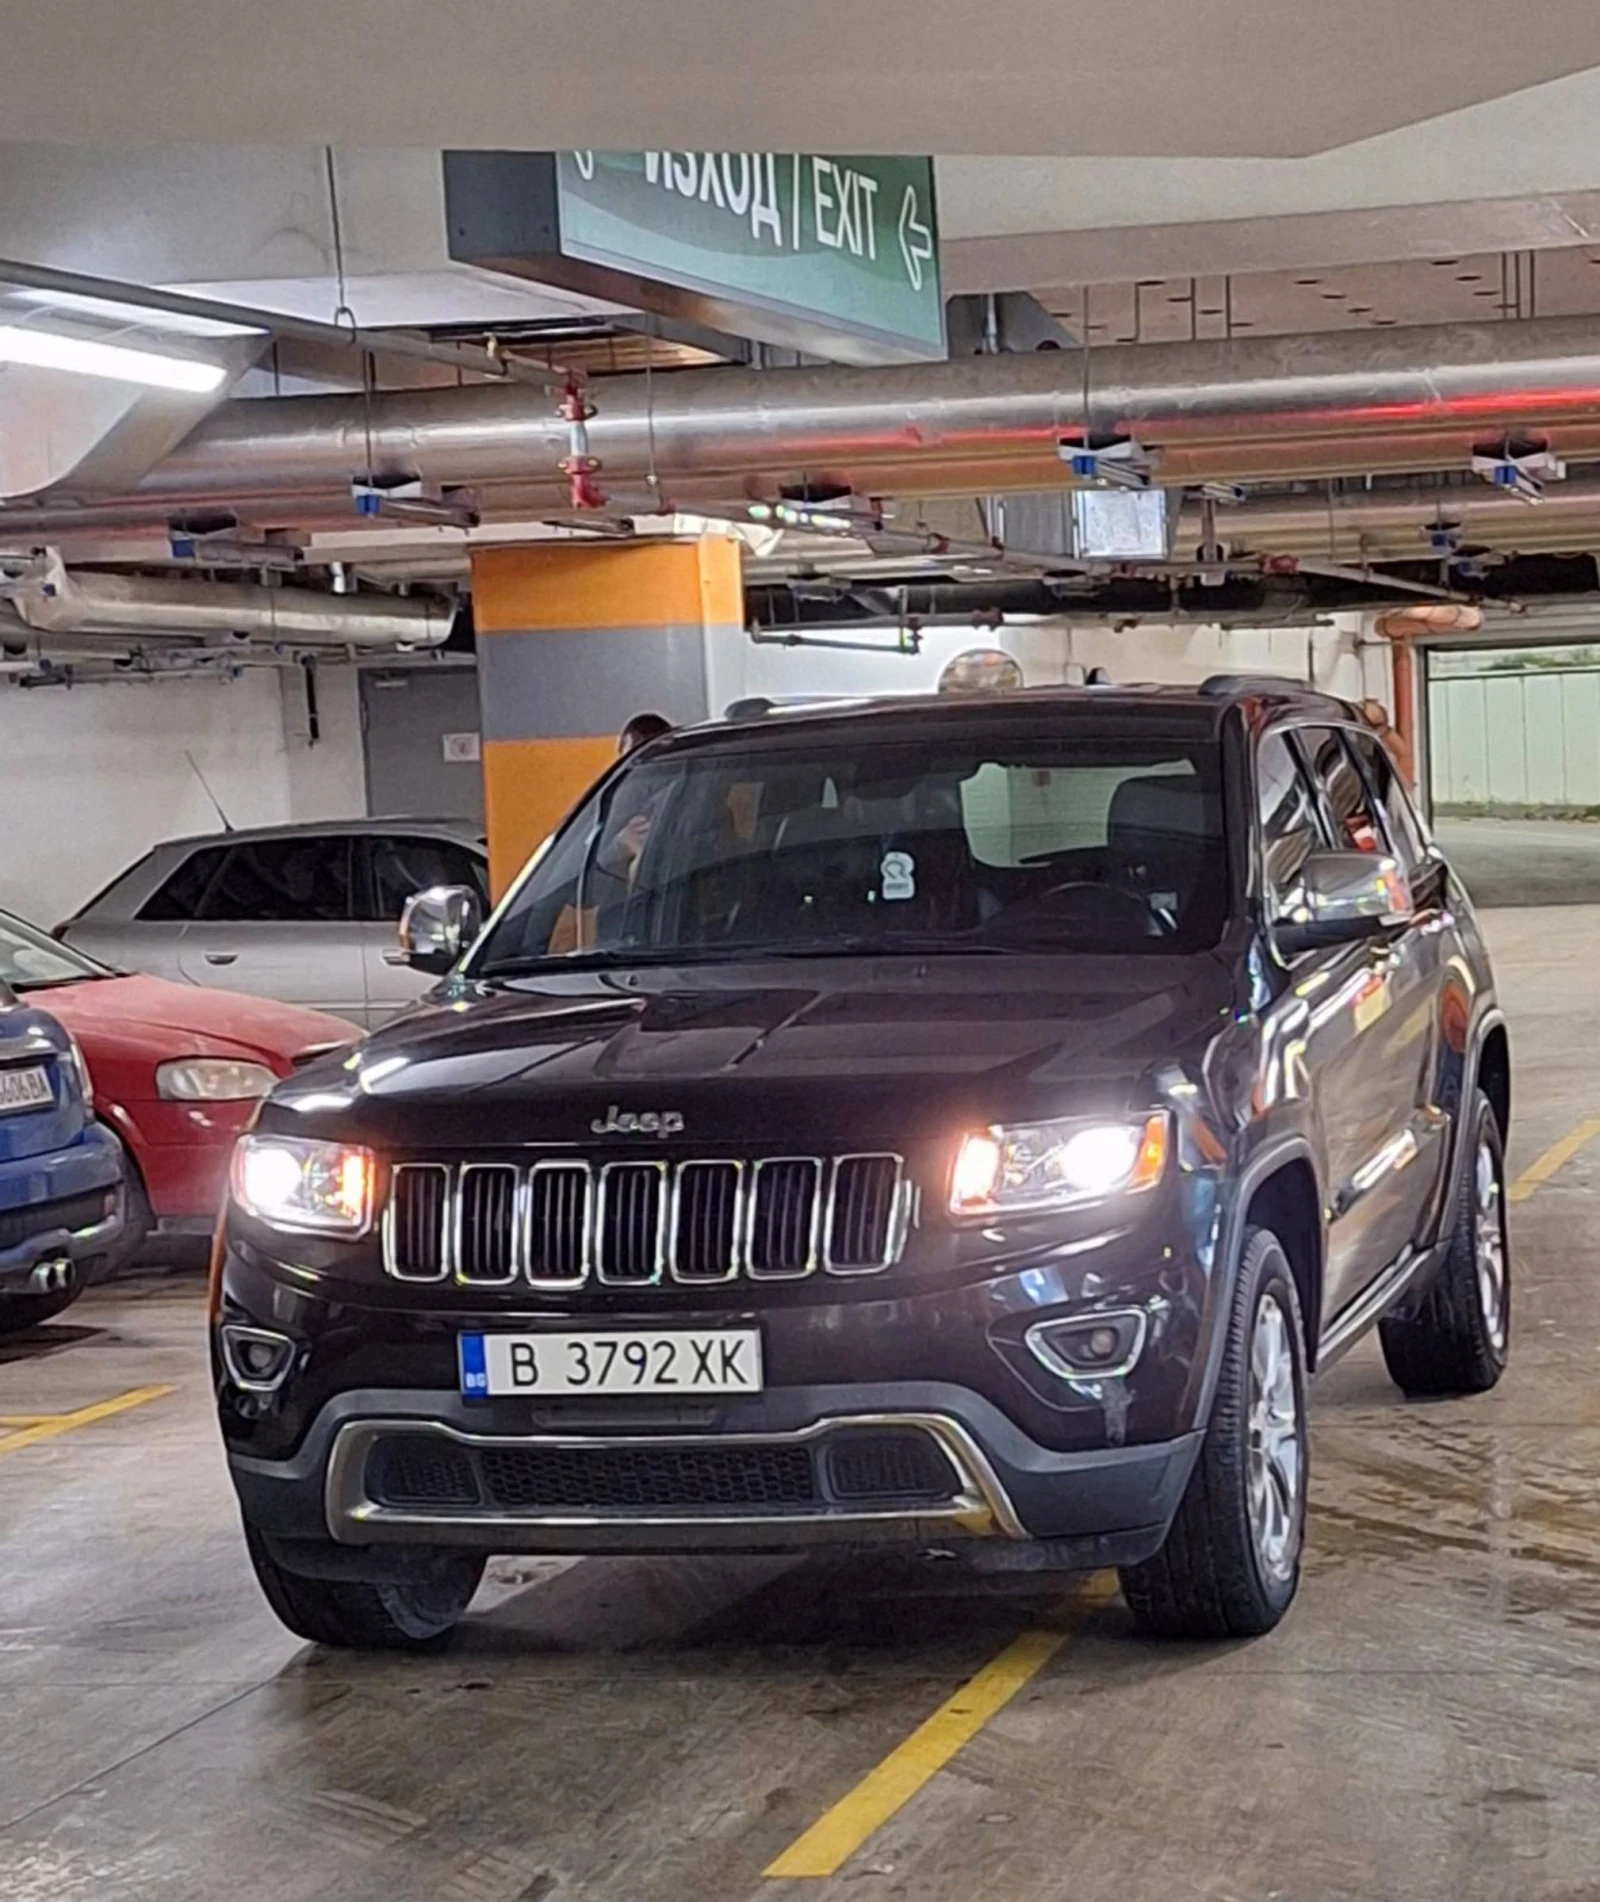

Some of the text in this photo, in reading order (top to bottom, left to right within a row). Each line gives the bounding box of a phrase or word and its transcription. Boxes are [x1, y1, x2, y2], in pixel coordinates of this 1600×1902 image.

[812, 156, 878, 261] EXIT
[590, 1105, 684, 1138] Jeep
[510, 1342, 539, 1387] B
[566, 1340, 679, 1386] 3792
